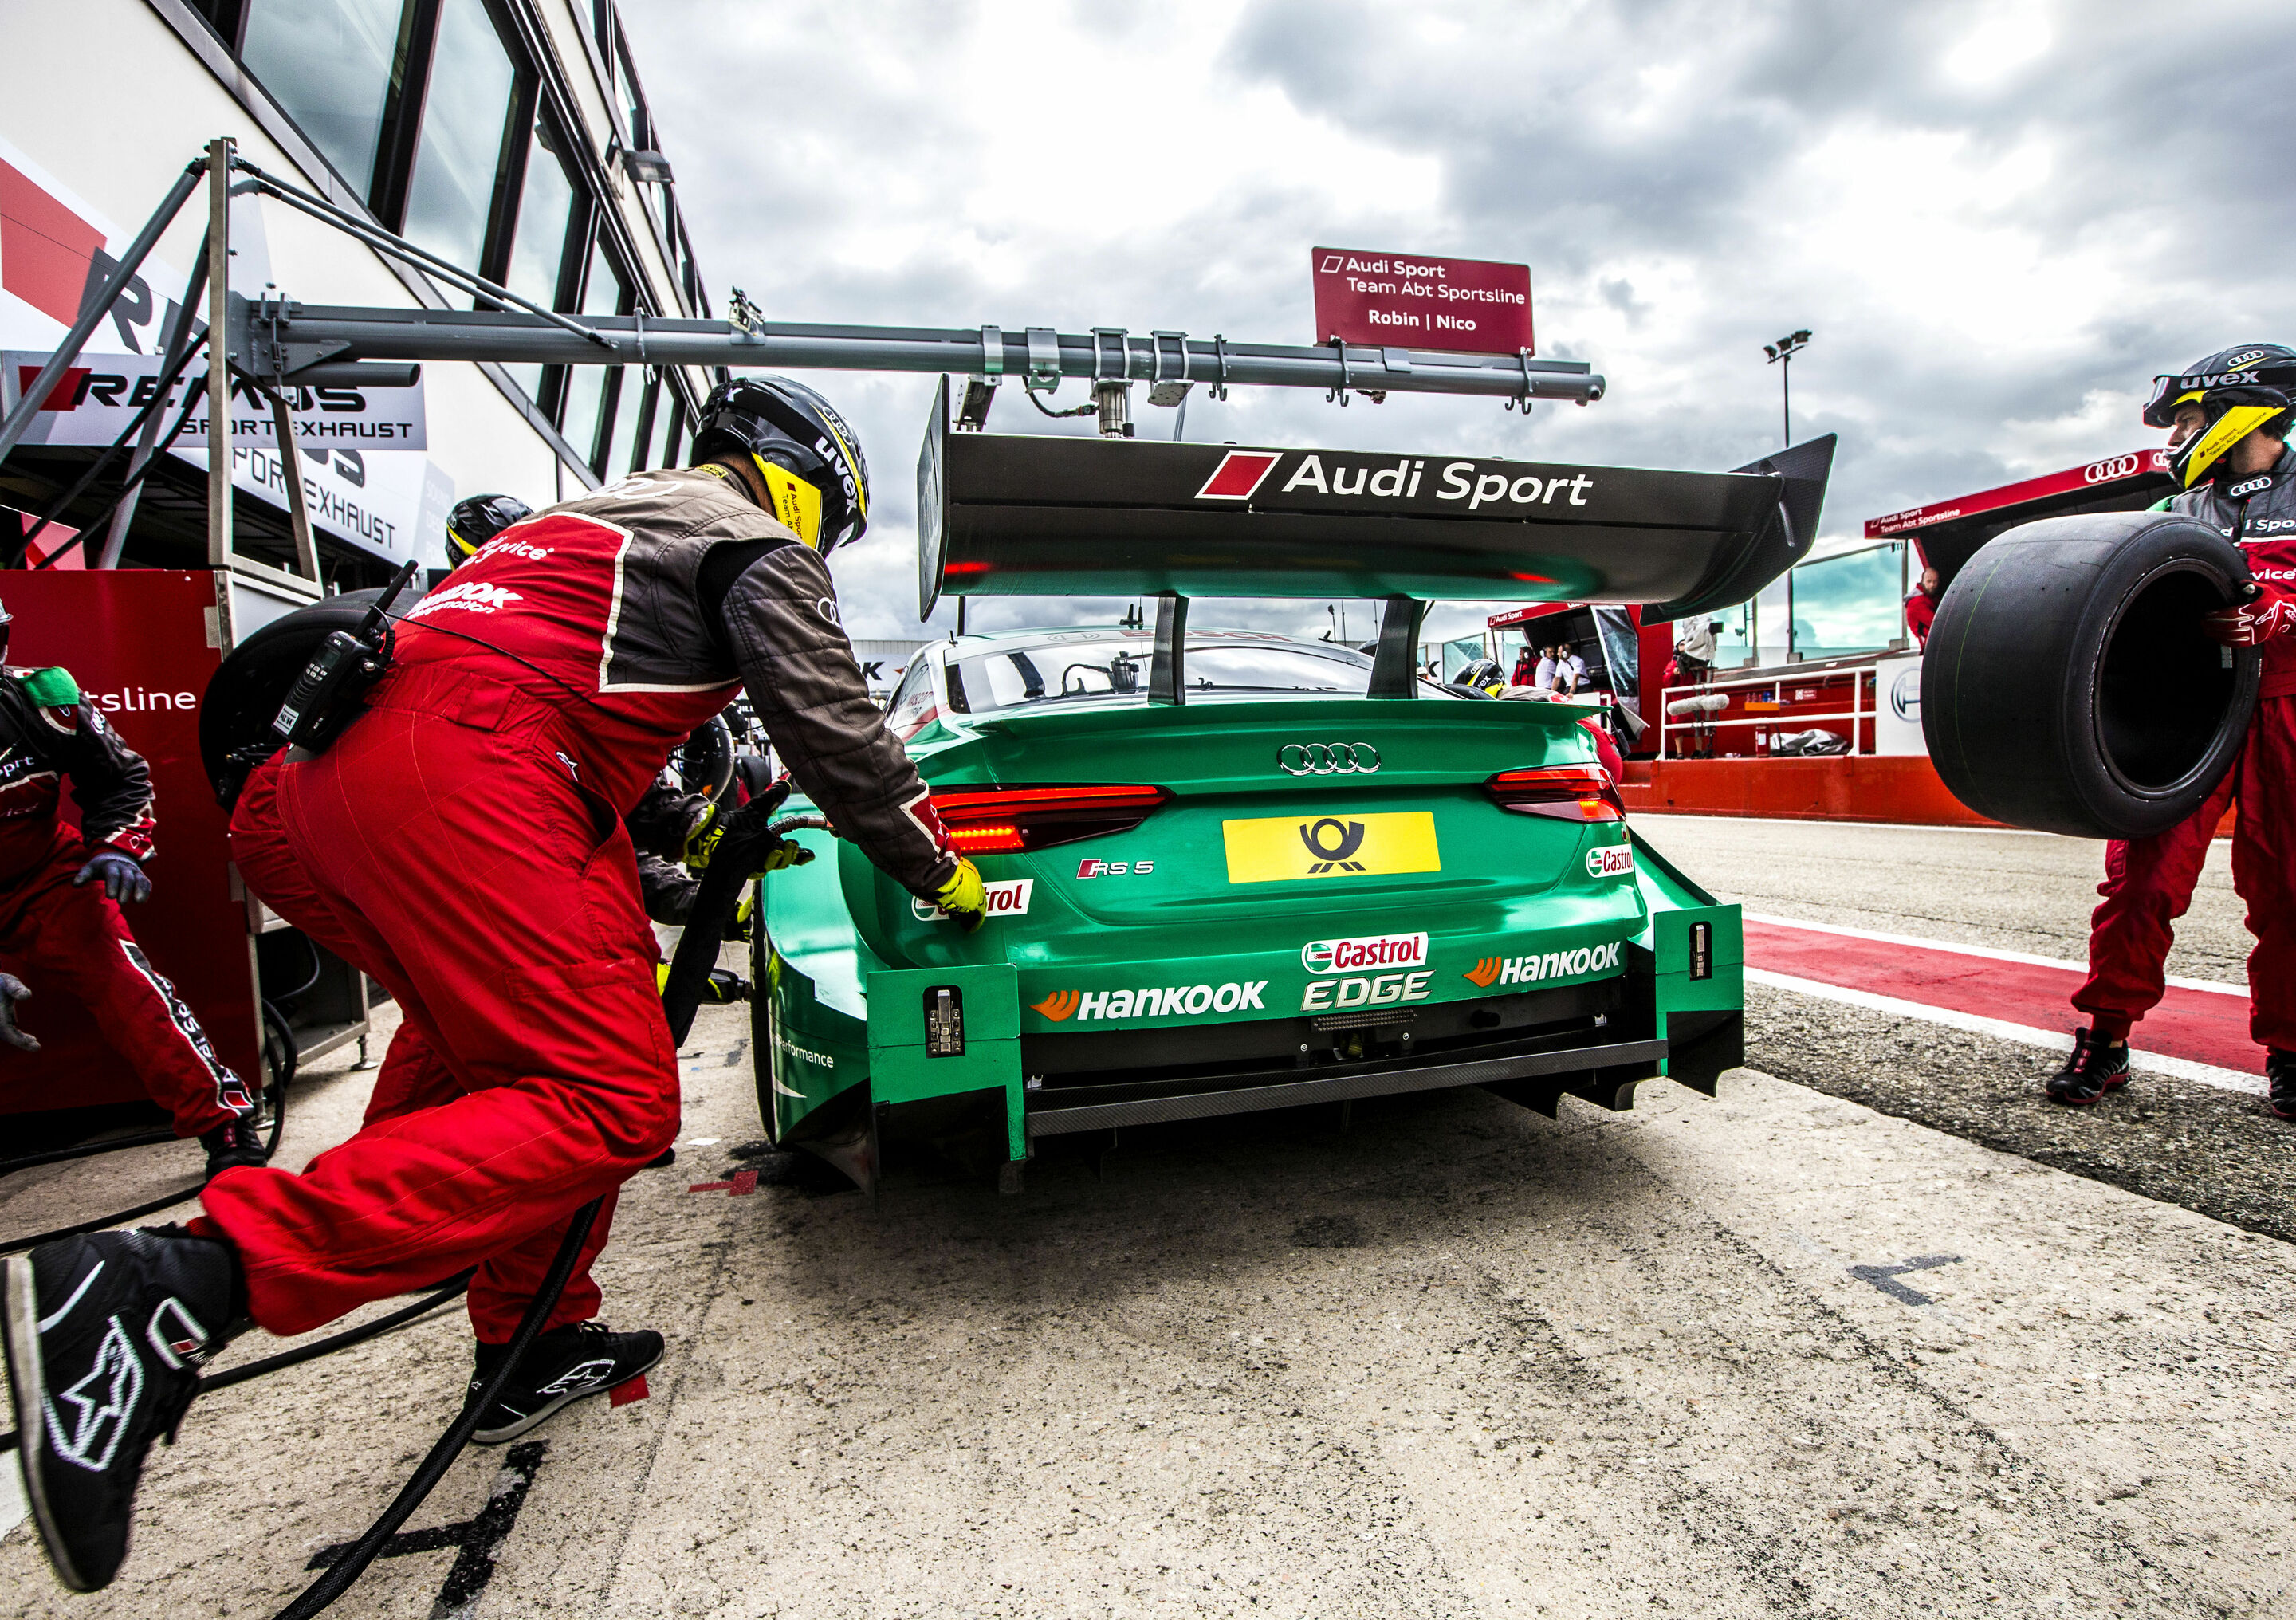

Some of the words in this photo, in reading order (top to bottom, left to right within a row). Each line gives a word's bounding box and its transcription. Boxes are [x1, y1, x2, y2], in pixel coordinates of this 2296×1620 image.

[1346, 258, 1389, 274] Audi
[1394, 261, 1445, 278] Sport
[1347, 277, 1396, 294] Team
[1402, 281, 1433, 297] Abt
[1438, 284, 1525, 305] Sportsline
[1369, 309, 1419, 327] Robin
[1437, 315, 1476, 331] Nico
[2180, 370, 2260, 390] uvex
[71, 372, 367, 413] REMS
[814, 435, 859, 517] uvex
[1282, 454, 1425, 498] Audi
[1436, 462, 1594, 510] Sport
[781, 494, 791, 519] Team
[790, 493, 800, 514] Audi
[1880, 514, 1899, 525] Audi
[1900, 508, 1923, 521] Sport
[1881, 521, 1901, 533] Team
[1902, 519, 1917, 529] Abt
[1918, 509, 1960, 525] Sportsline
[2255, 519, 2296, 533] Spo
[2252, 568, 2296, 580] vice
[1495, 614, 1508, 623] Audi
[1508, 610, 1523, 620] Sport
[1119, 630, 1294, 643] BSCH
[1089, 861, 1129, 876] RS
[1134, 860, 1154, 875] 5
[1603, 847, 1633, 873] Castrol
[1335, 936, 1421, 968] Castrol
[1300, 969, 1436, 1012] EDGE
